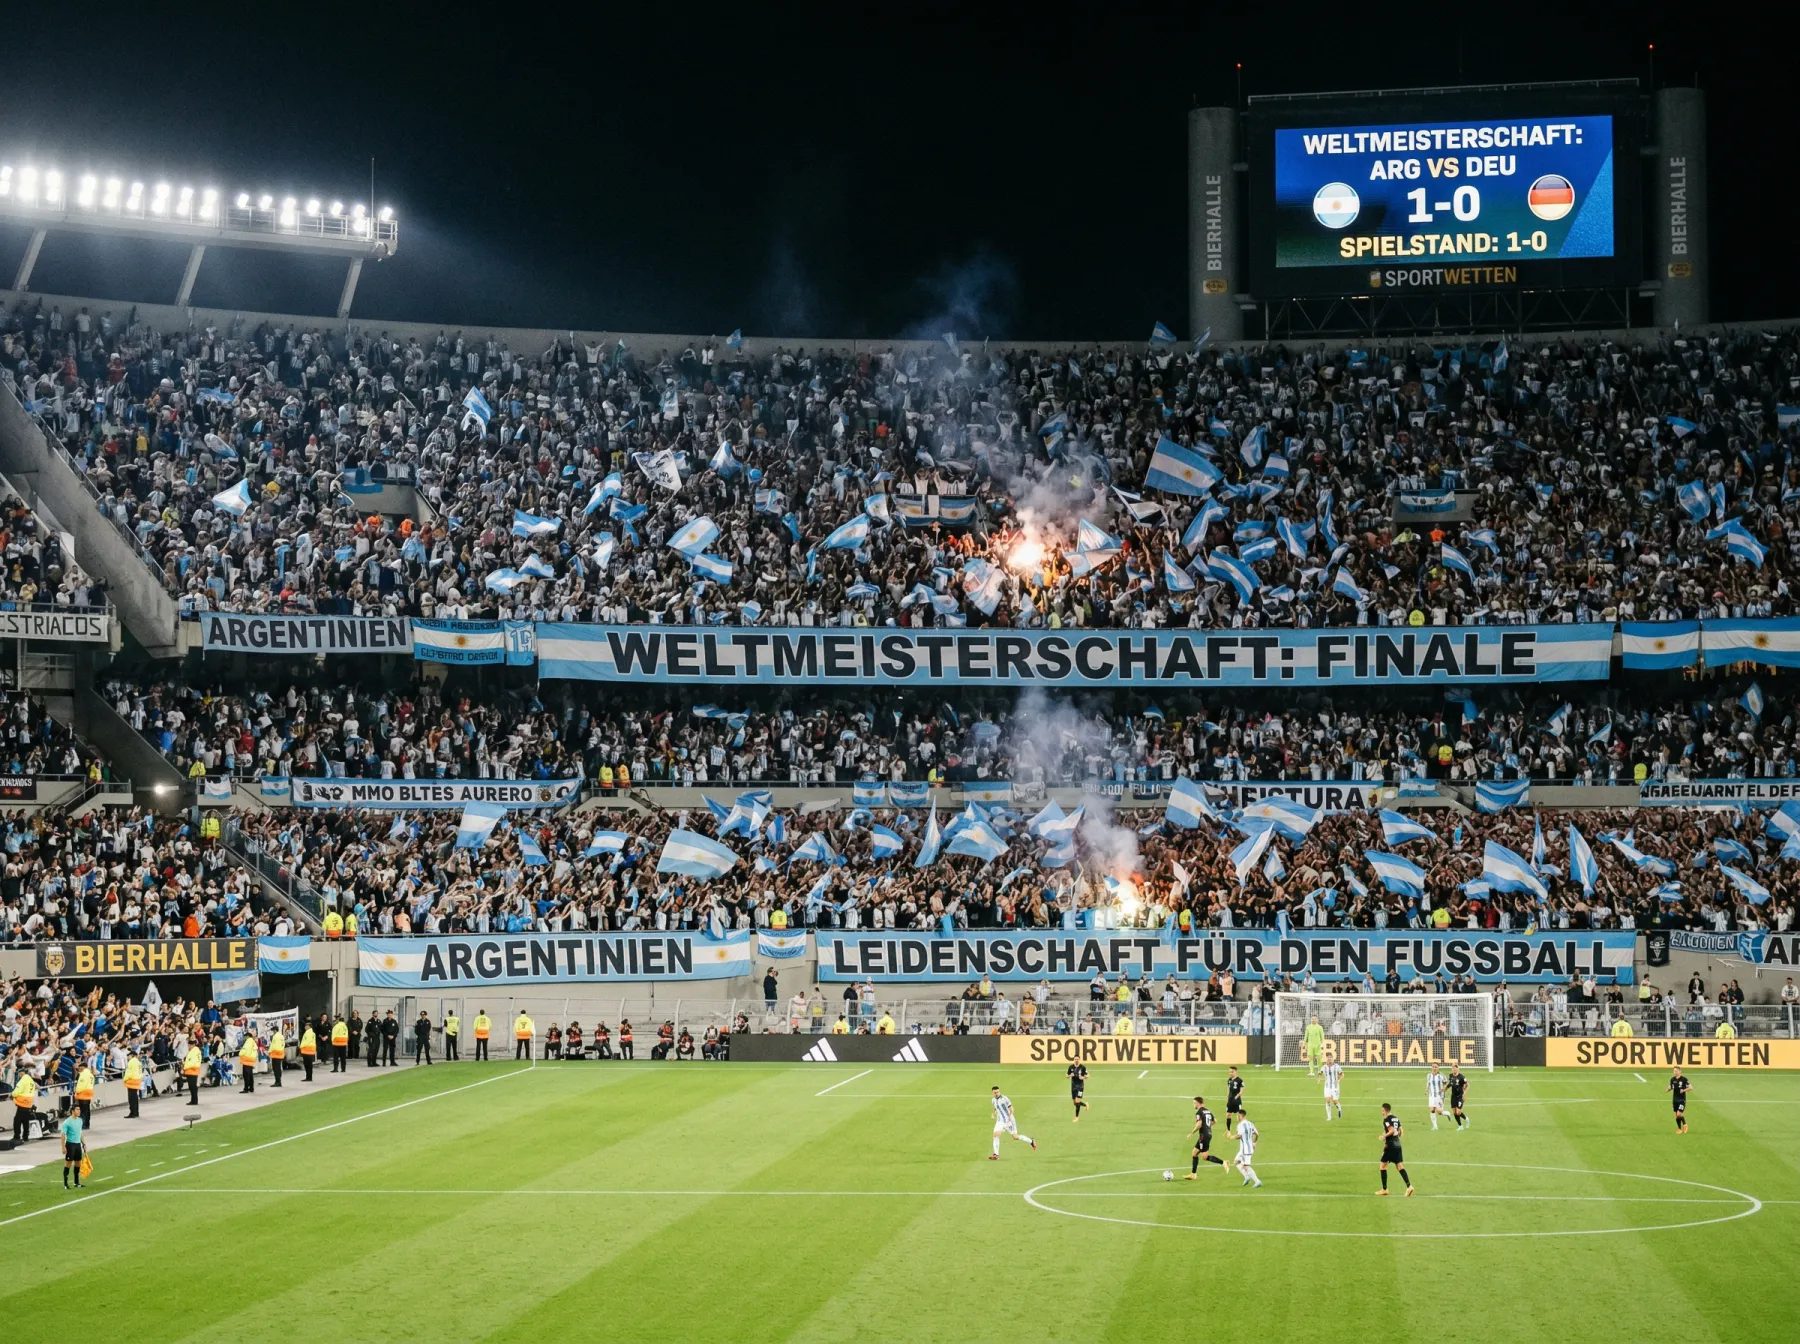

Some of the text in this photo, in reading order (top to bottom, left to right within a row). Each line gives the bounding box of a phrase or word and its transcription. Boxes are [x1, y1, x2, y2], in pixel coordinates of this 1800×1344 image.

[1303, 124, 1583, 155] WELTMEISTERSCHAFT:
[1370, 155, 1517, 181] ARG VS DEU
[1407, 186, 1480, 223] 1-0
[1670, 157, 1687, 255] BIERHALLE
[1206, 175, 1222, 271] BIERHALLE
[1340, 231, 1548, 258] SPIELSTAND: 1-0
[1385, 267, 1517, 287] SPORTWETTEN
[208, 617, 406, 649] ARGENTINIEN
[606, 631, 1537, 680] WELTMEISTERSCHAFT: FINALE
[352, 786, 394, 801] MMO
[461, 787, 533, 801] AURERO
[76, 941, 246, 973] BIERHALLE
[421, 934, 695, 982] ARGENTINIEN
[833, 937, 1161, 976] LEIDENSCHAFT
[1177, 930, 1265, 974] FÜR
[1280, 940, 1369, 975] DEN
[1386, 940, 1617, 977] FUSSBALL
[1030, 1038, 1216, 1062] SPORTWETTEN
[1322, 1039, 1475, 1063] BIERHALLE
[1577, 1041, 1770, 1066] SPORTWETTEN
